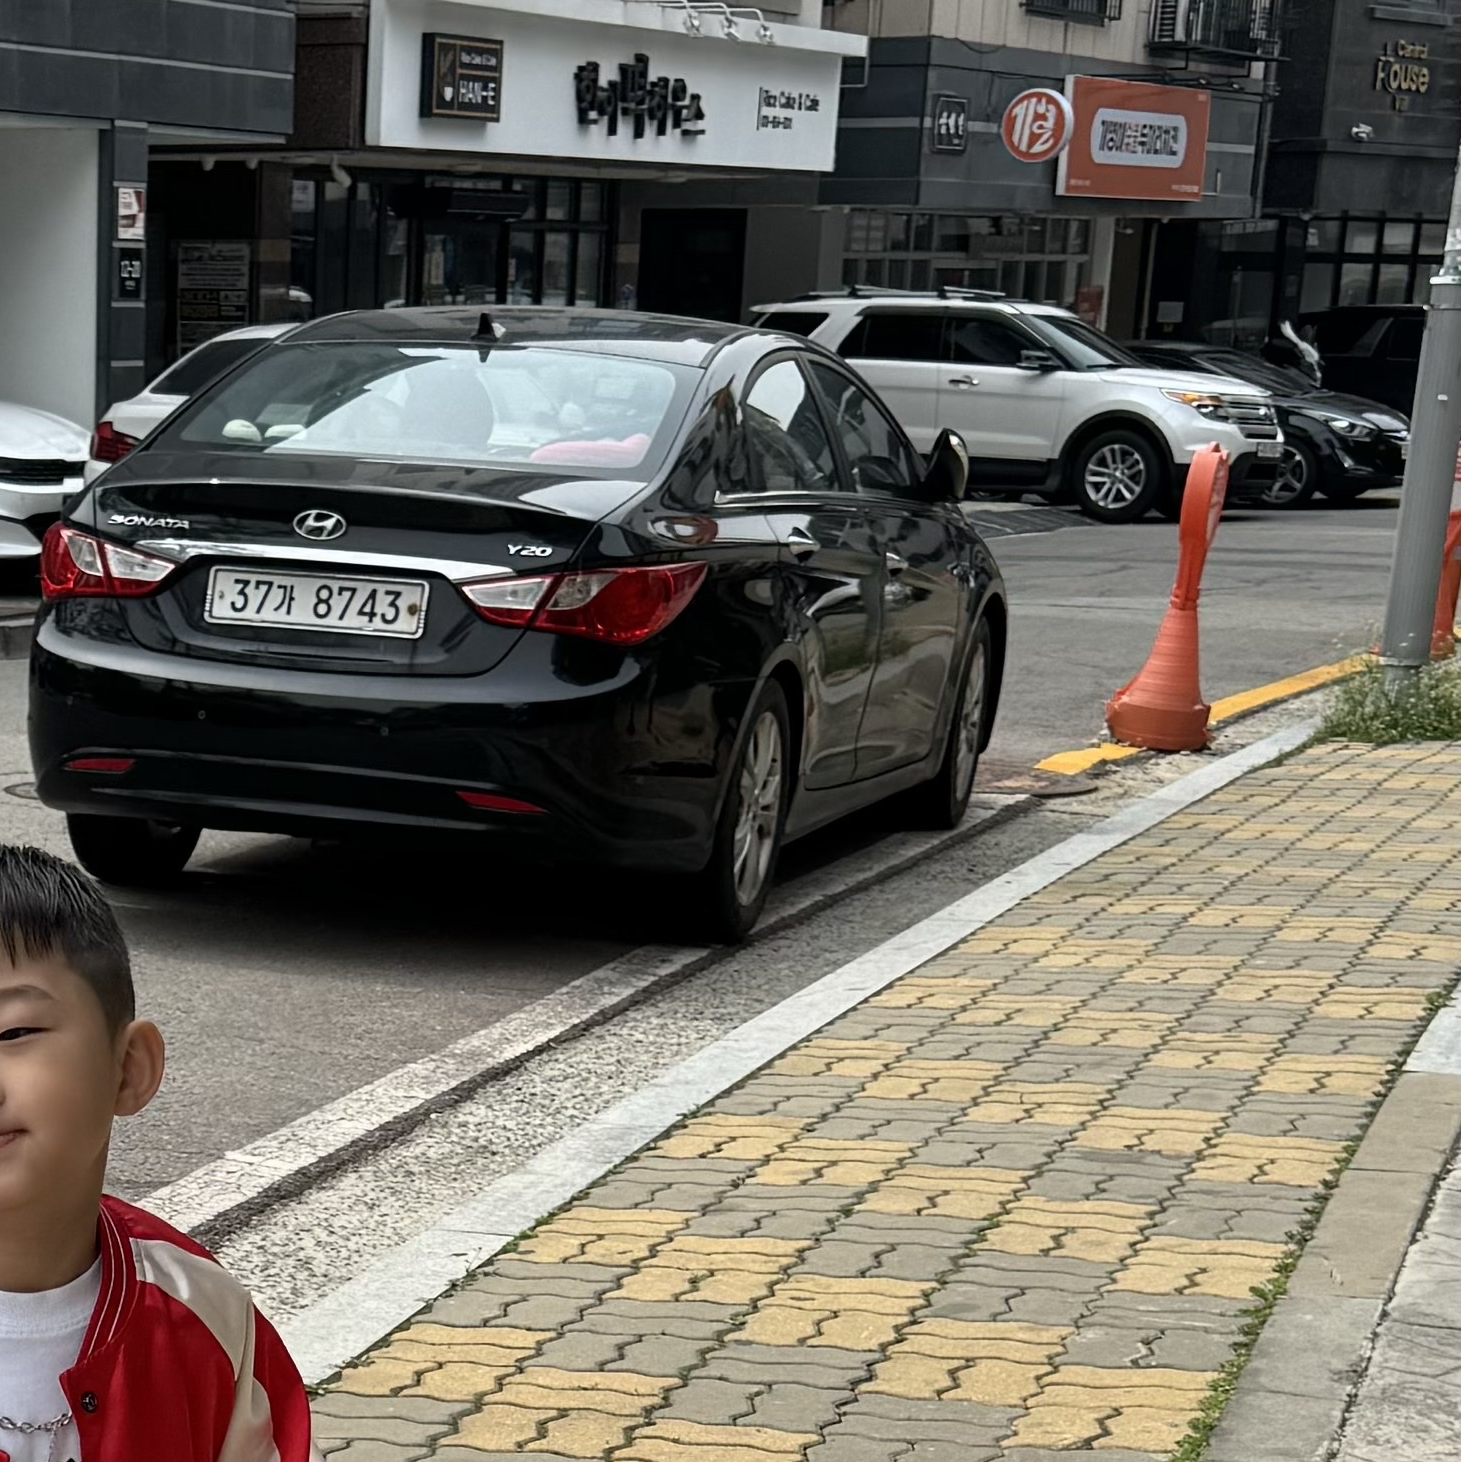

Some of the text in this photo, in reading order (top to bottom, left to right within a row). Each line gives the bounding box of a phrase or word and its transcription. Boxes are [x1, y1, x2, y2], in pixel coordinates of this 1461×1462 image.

[107, 514, 190, 529] SONATA
[507, 544, 553, 557] Y20
[229, 578, 403, 625] 37가 8743
